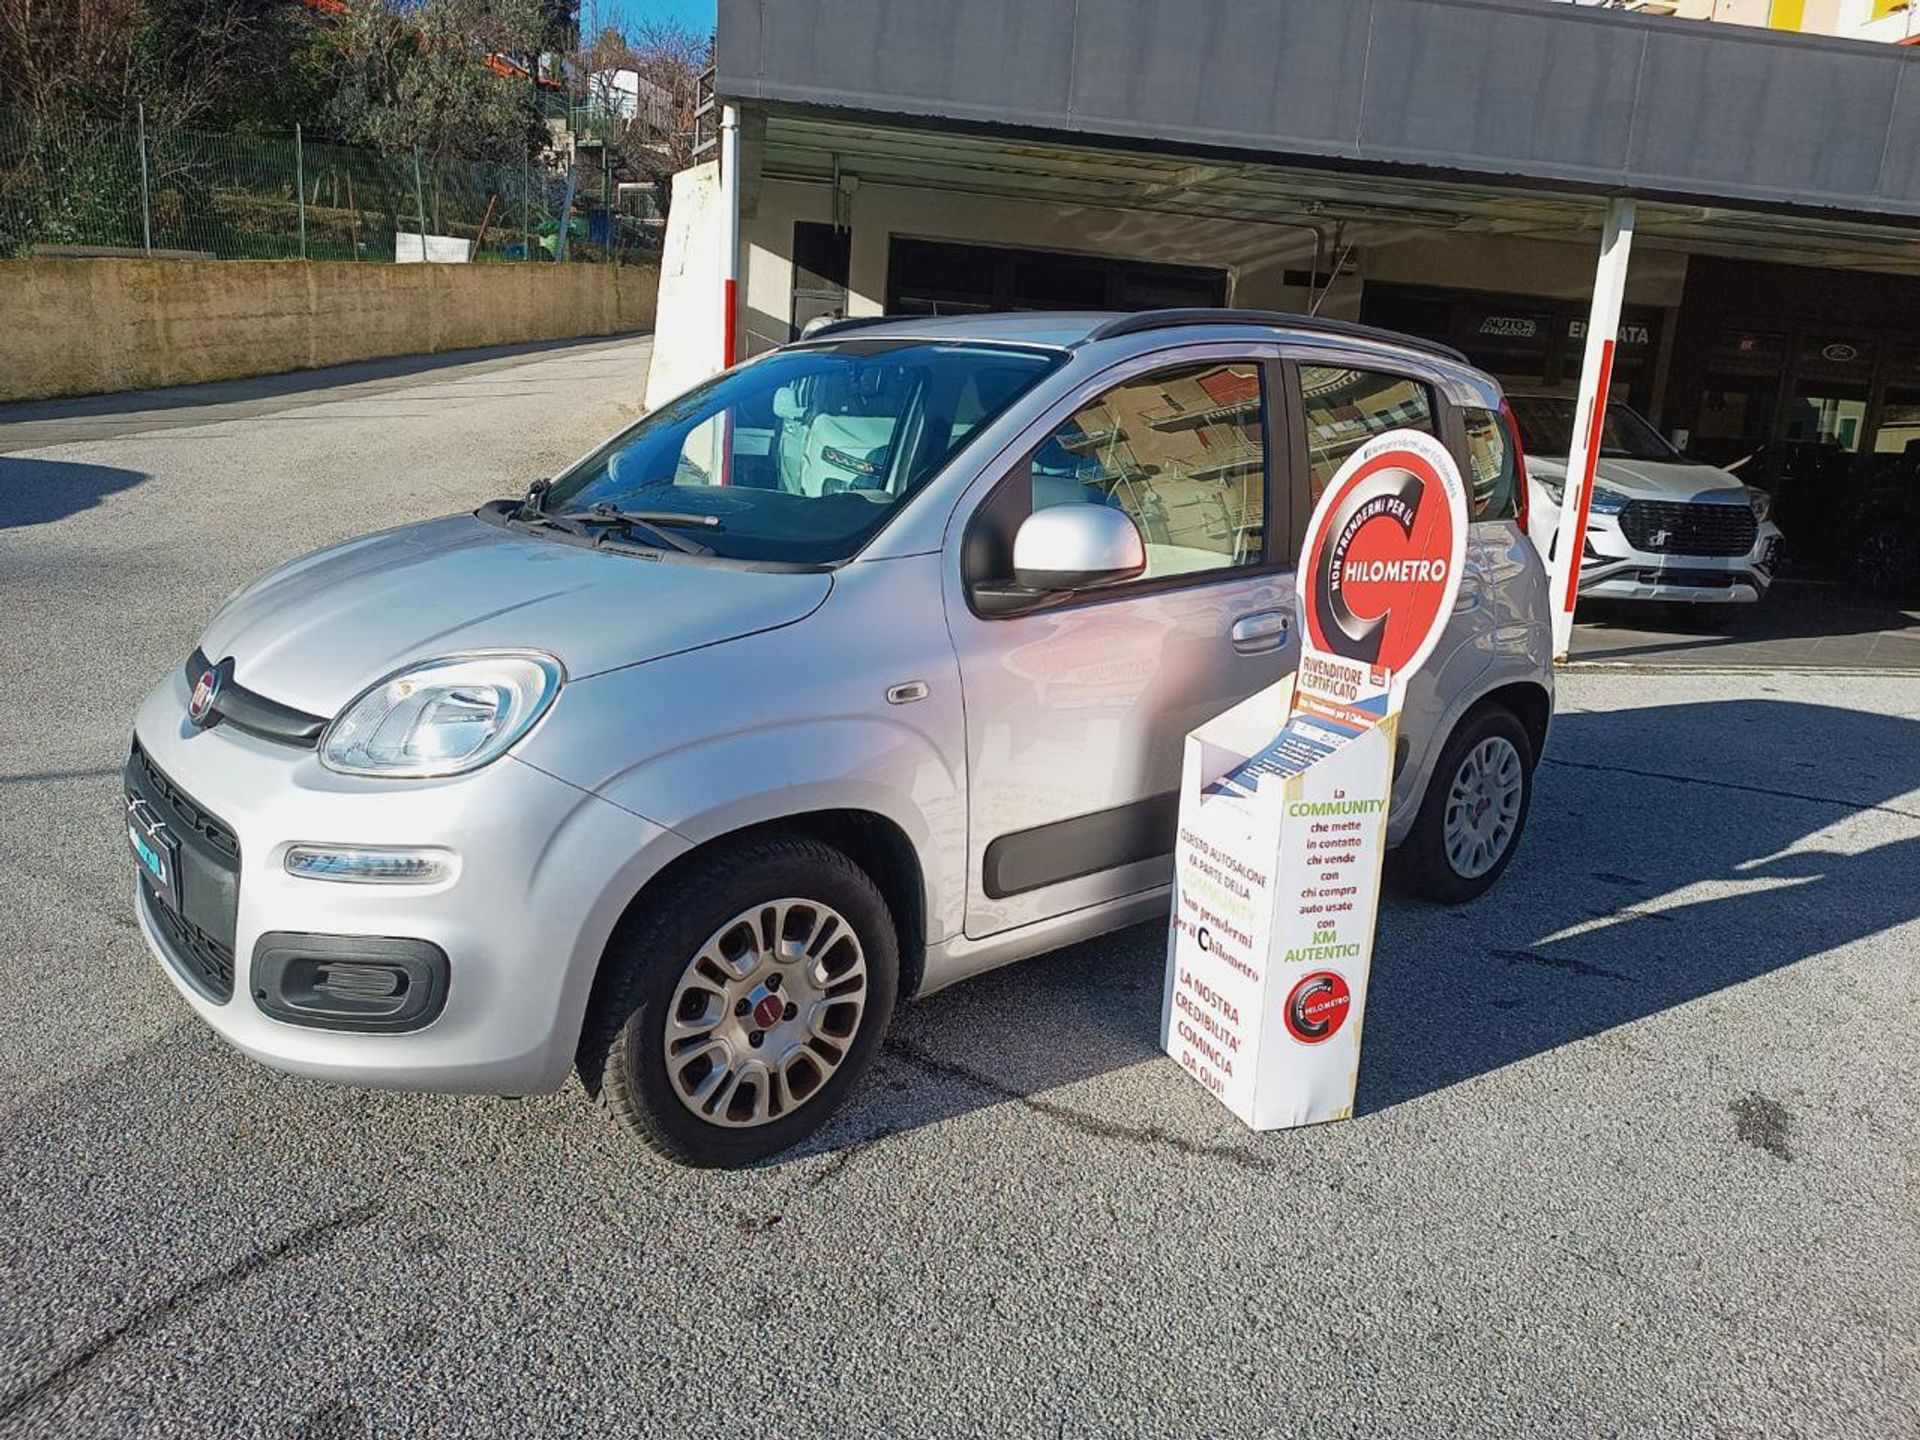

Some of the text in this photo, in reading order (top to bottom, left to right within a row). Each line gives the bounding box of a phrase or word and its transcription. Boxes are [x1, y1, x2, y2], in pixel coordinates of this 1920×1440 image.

[1568, 320, 1649, 344] ENATA
[1331, 498, 1415, 590] NON PRENDERMI PER IL
[1304, 656, 1363, 686] RIVENDITORE
[1302, 672, 1357, 701] CERTIFICATO
[1334, 789, 1345, 800] La
[1289, 800, 1385, 817] COMMUNITY
[1310, 821, 1362, 833] che mette
[1306, 837, 1362, 850] in contatto
[1181, 828, 1267, 889] QUESTO AUTOSALONE
[1307, 854, 1356, 866] chi vende
[1199, 859, 1223, 885] PARTE
[1224, 875, 1251, 901] DELLA
[1320, 872, 1339, 881] con
[1301, 886, 1357, 900] chi compra
[1299, 902, 1353, 915] auto usate
[1200, 905, 1253, 949] prendermi
[1317, 918, 1335, 929] con
[1172, 915, 1260, 983] per il Chilometro
[1312, 930, 1337, 945] KM
[1284, 943, 1361, 963] AUTENTICI
[1179, 967, 1240, 1026] LA NOSTRA
[1175, 991, 1242, 1053] CREDIBILITA'
[1178, 1020, 1233, 1077] COMINCIA
[1182, 1049, 1198, 1074] DA
